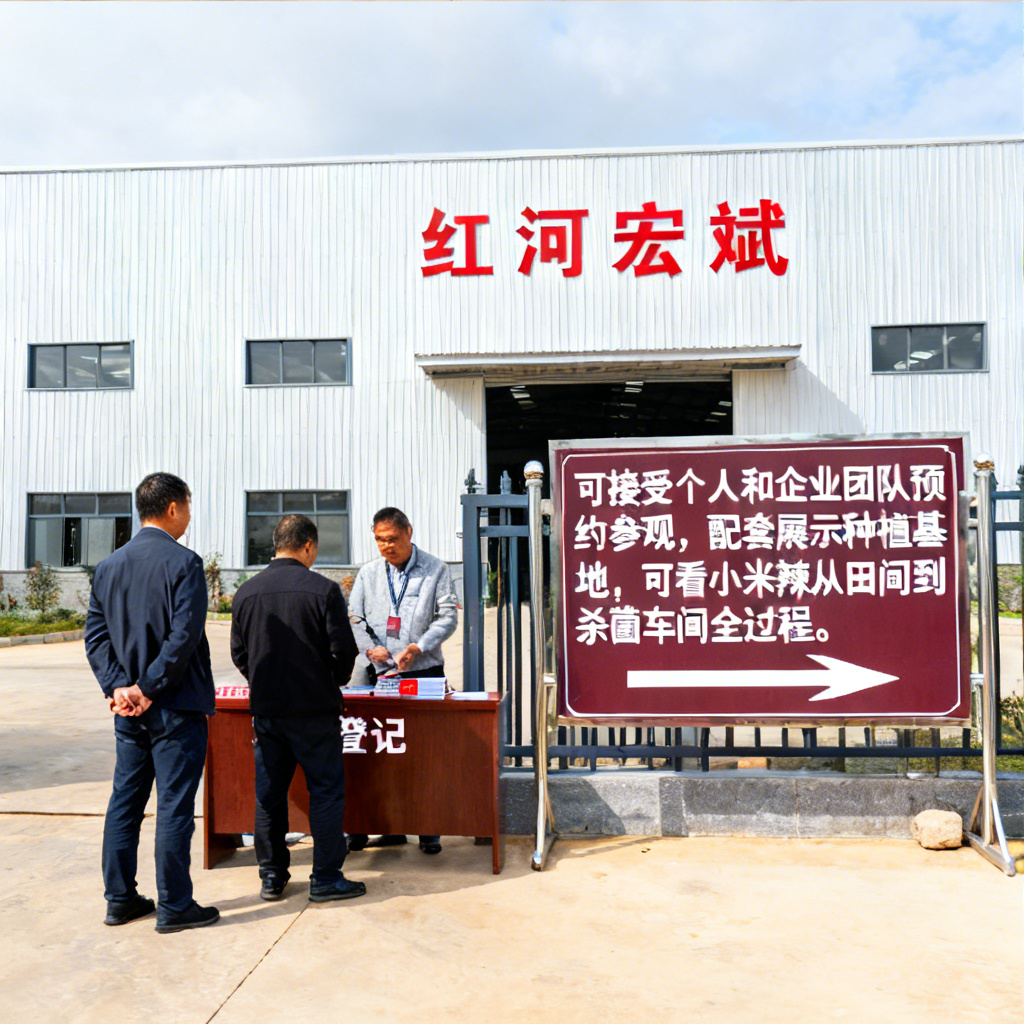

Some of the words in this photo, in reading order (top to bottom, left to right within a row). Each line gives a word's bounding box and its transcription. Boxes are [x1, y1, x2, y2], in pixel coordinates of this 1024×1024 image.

[421, 199, 789, 277] 红河宏斌
[574, 464, 946, 507] 可接受个人和企业团队预
